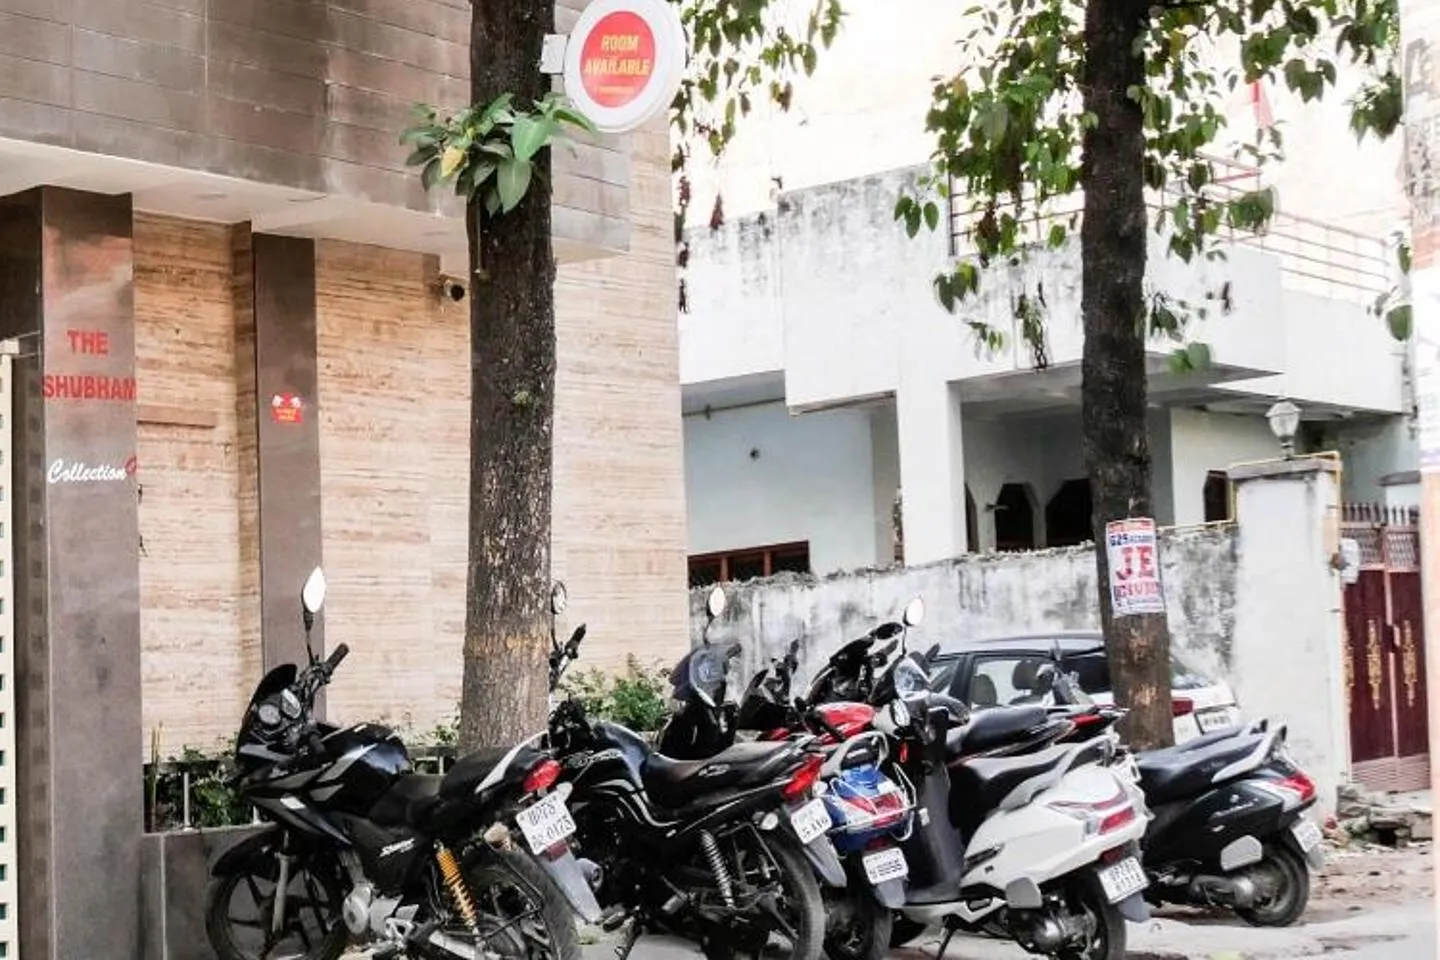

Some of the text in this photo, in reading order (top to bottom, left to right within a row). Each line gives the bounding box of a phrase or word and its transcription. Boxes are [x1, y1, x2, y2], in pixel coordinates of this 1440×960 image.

[601, 35, 640, 52] ROOM
[585, 58, 651, 75] AVAILABLE
[67, 329, 109, 355] THE
[47, 458, 128, 484] Collection
[1115, 546, 1154, 580] JE
